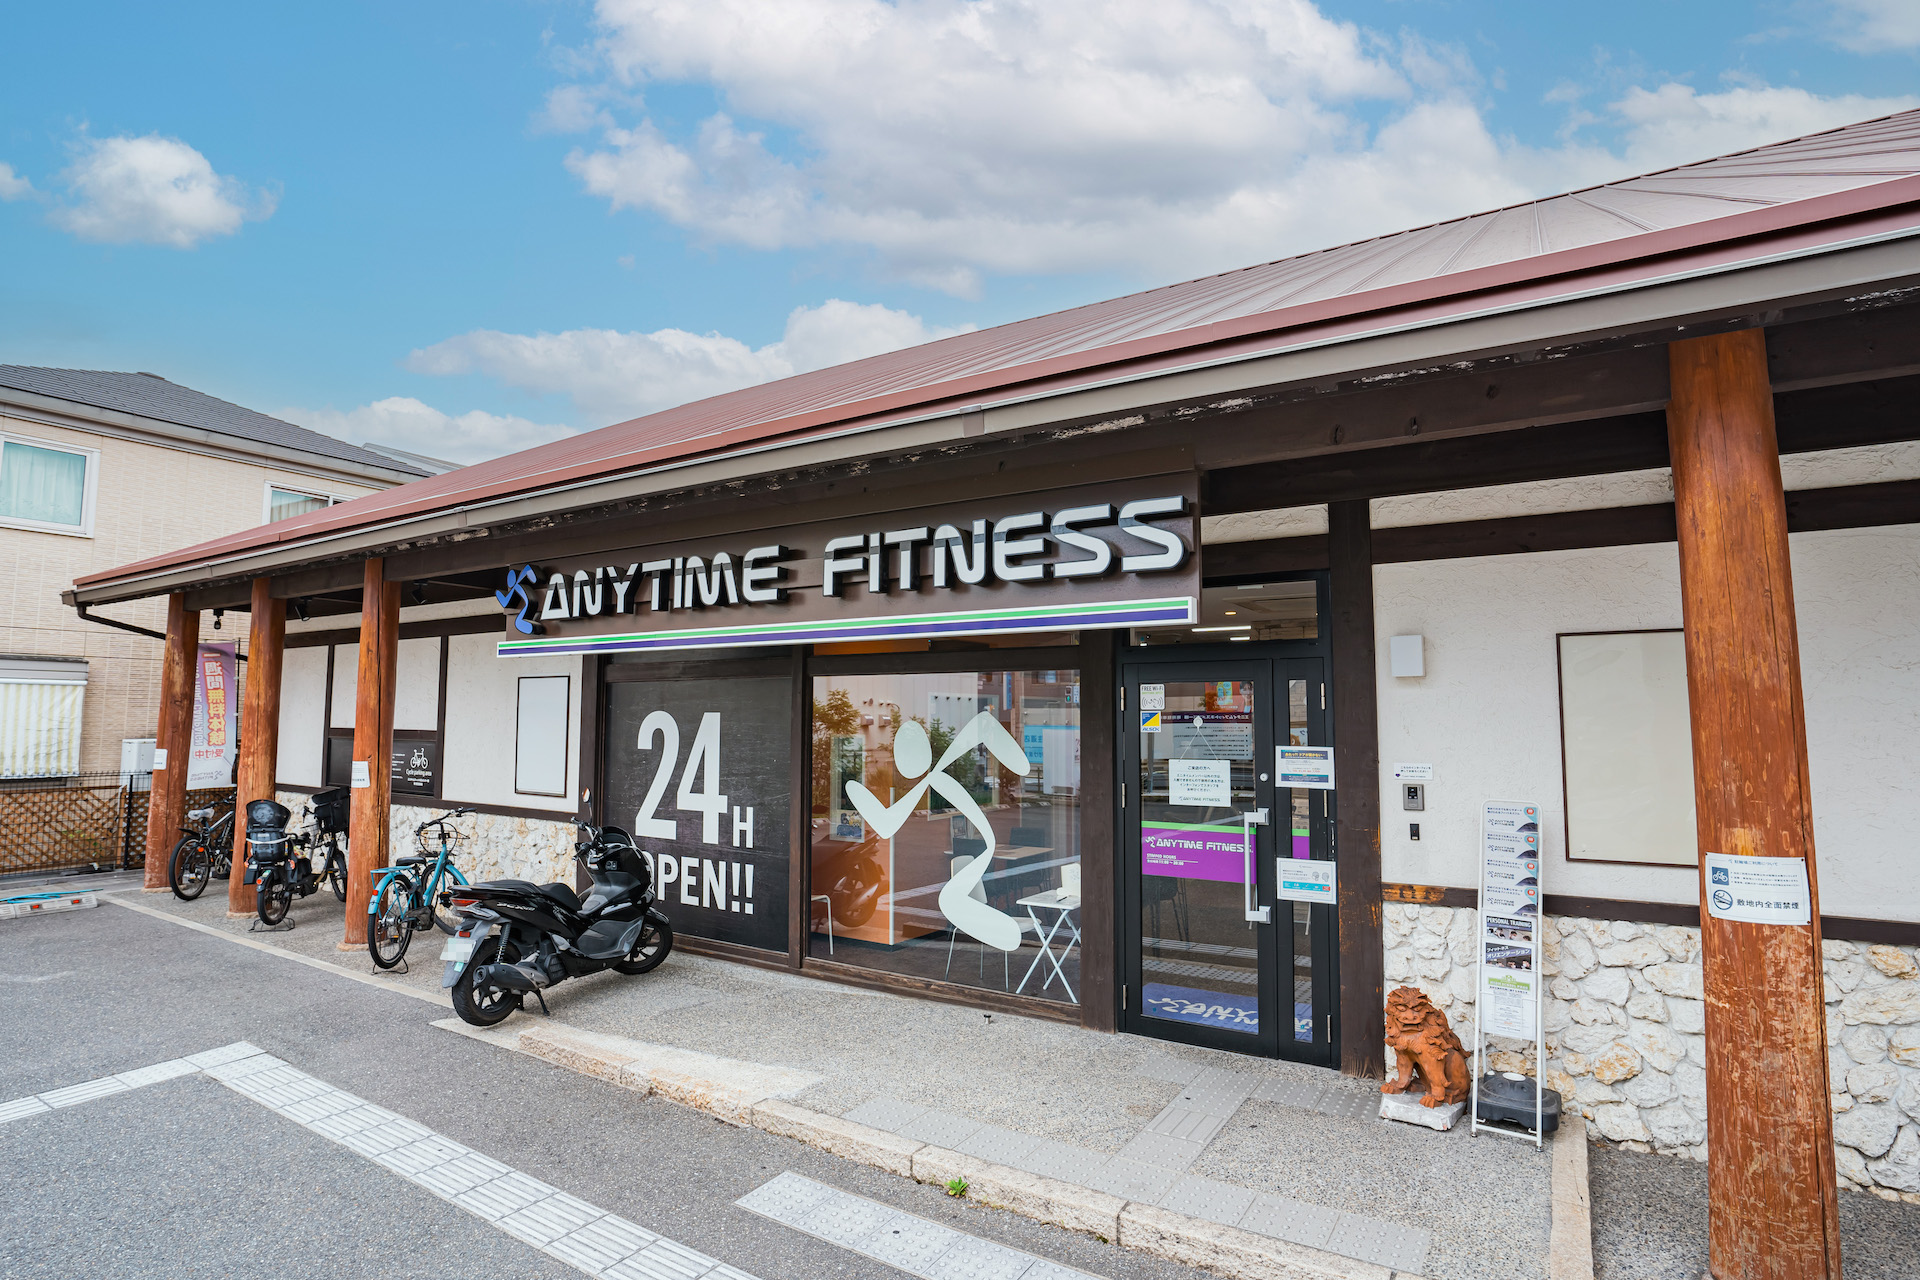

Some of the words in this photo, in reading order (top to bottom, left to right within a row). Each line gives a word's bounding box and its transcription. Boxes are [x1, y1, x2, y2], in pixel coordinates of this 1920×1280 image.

[541, 545, 786, 621] ANYTIME
[823, 495, 1187, 598] FITNESS
[1156, 838, 1203, 850] ANYTIME
[1736, 899, 1800, 910] 敷地内全面禁煙
[1487, 917, 1510, 925] PERSONAL
[1510, 920, 1532, 928] TRAINING
[1486, 949, 1530, 959] オリエンテーション
